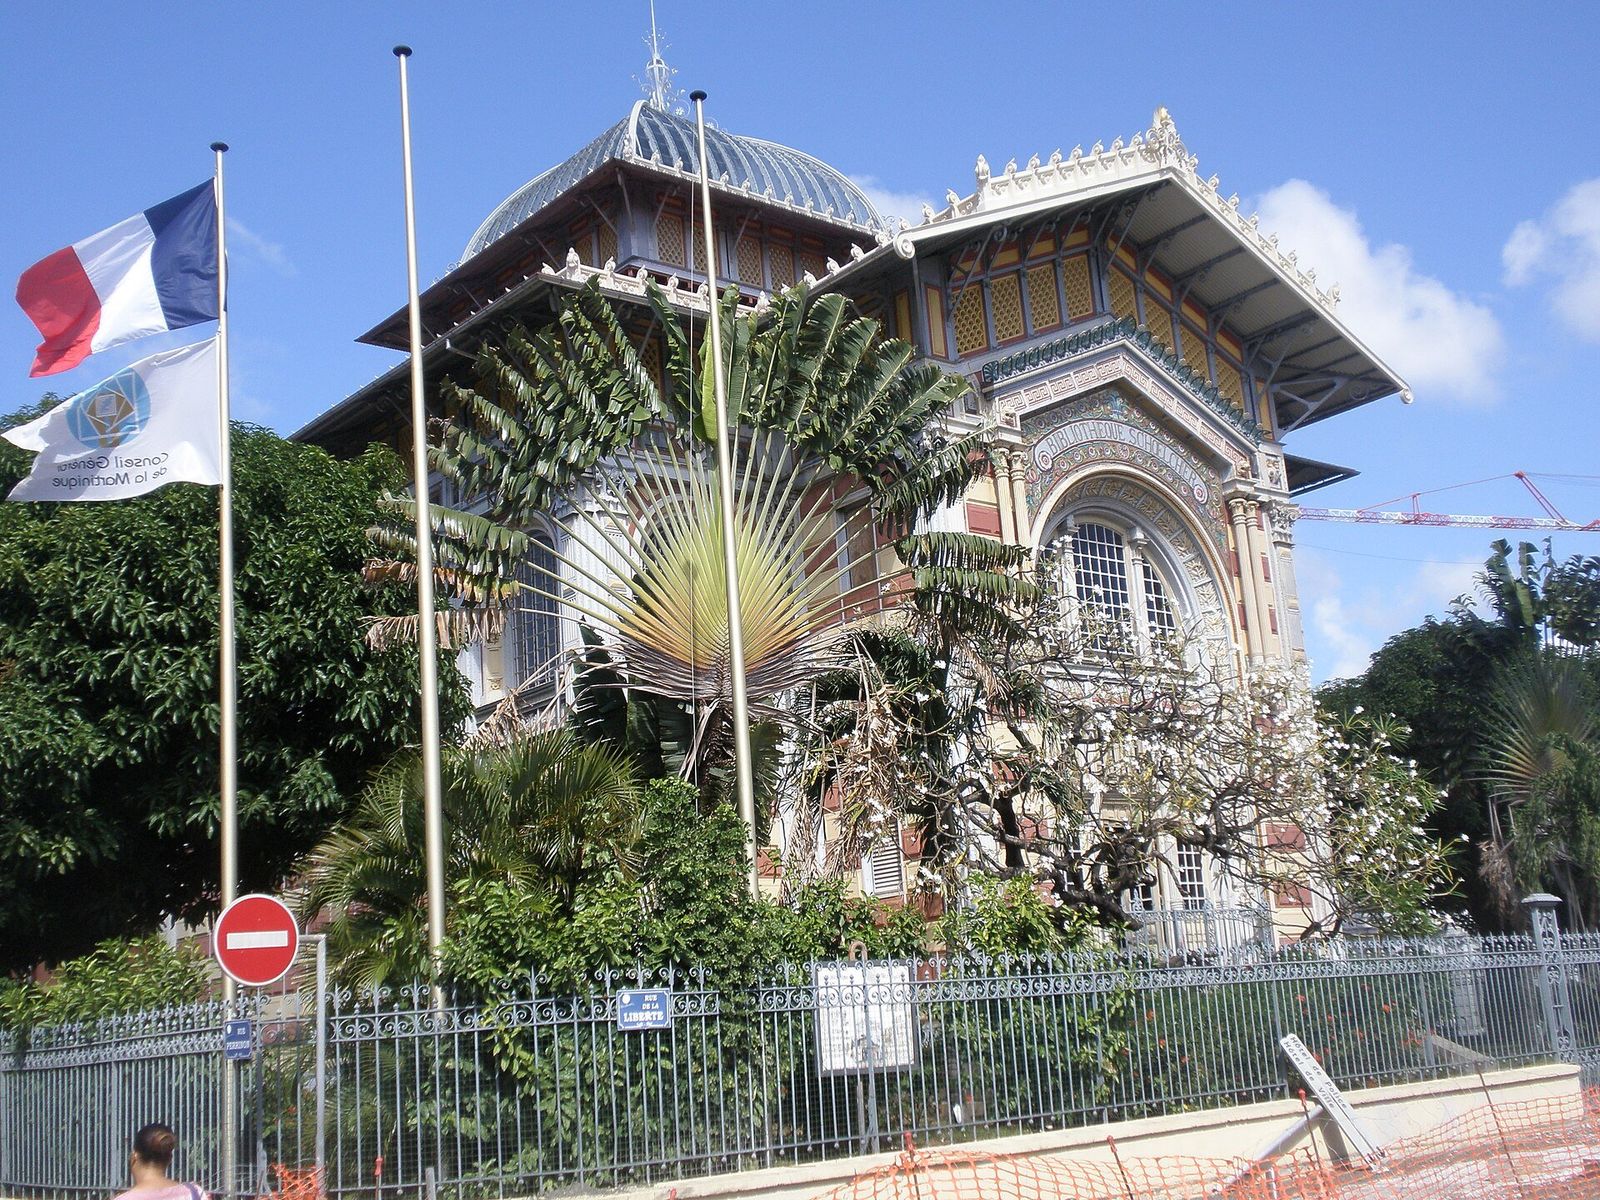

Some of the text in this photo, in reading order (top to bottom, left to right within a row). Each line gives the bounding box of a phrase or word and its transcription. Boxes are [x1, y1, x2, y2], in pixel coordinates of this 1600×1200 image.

[644, 994, 658, 1002] RUE
[651, 1002, 660, 1010] LA
[1283, 1041, 1335, 1109] Hôtel de Ville
[1290, 1035, 1348, 1109] Hôtel de Police
